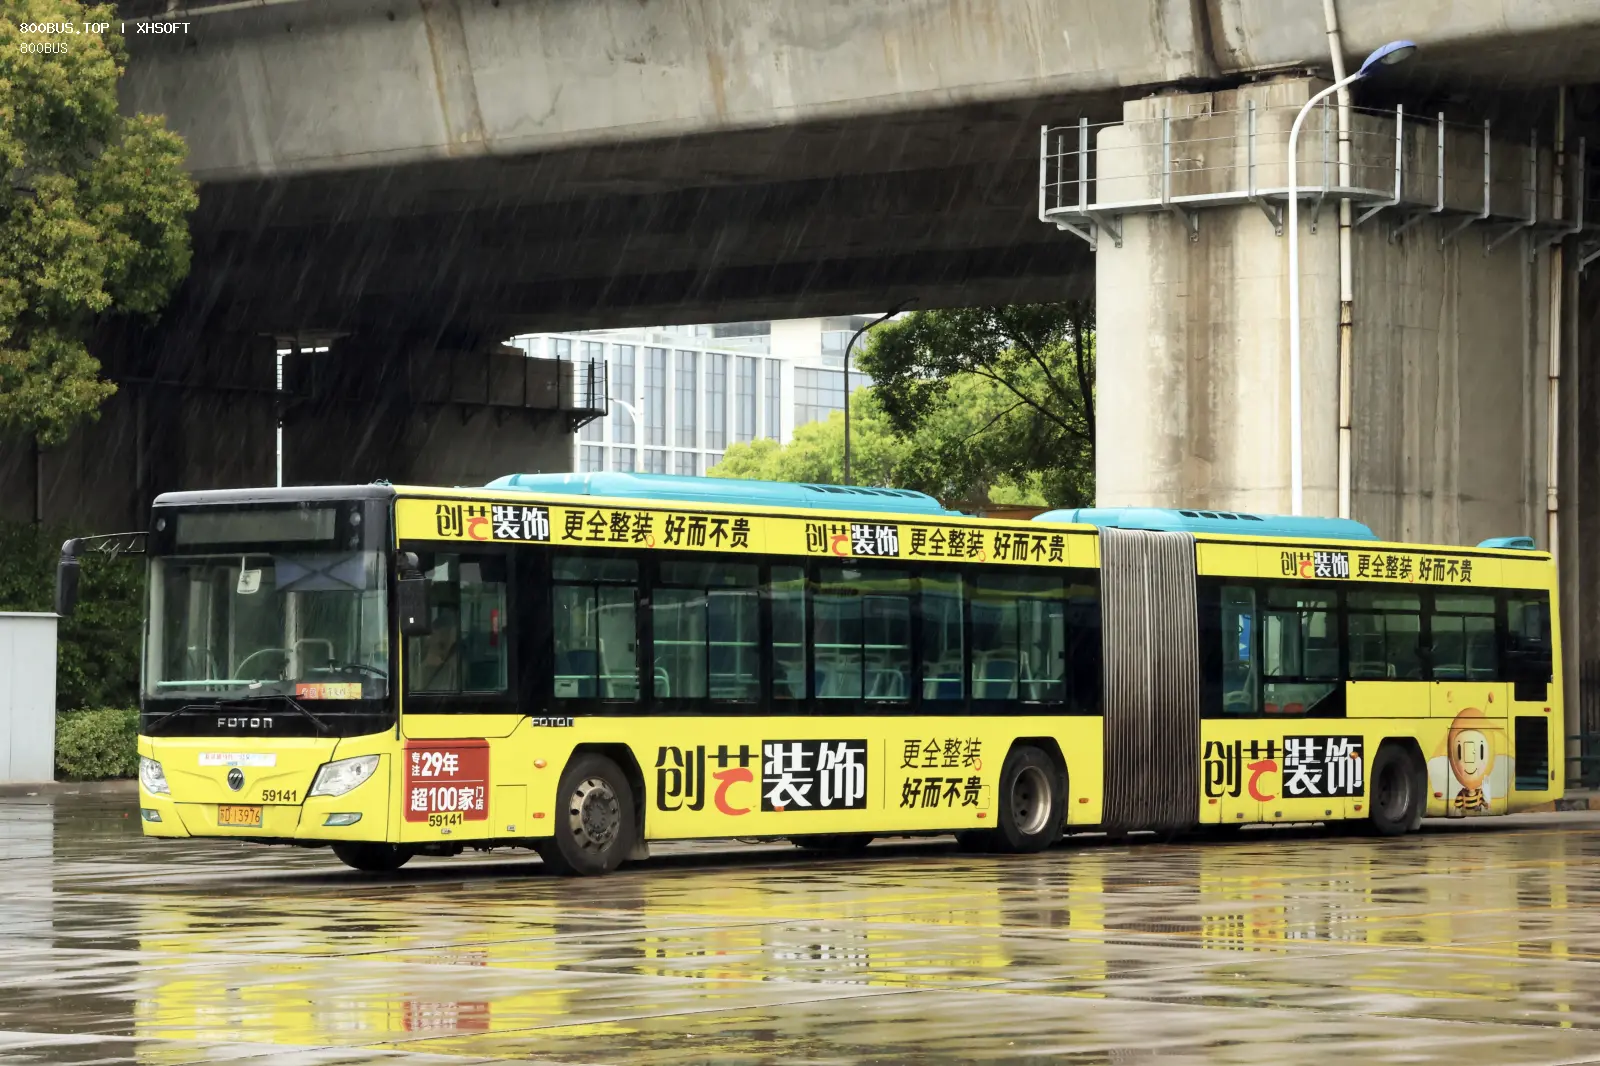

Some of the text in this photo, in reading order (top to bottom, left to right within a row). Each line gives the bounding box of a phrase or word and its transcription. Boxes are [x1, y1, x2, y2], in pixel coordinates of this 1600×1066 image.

[561, 509, 655, 548] 更全整装
[664, 514, 751, 549] 好而不贵
[909, 528, 986, 562] 更全整装
[993, 532, 1065, 563] 好而不贵
[1356, 554, 1414, 582] 更全整装
[1418, 557, 1473, 583] 好而不贵
[900, 737, 982, 771] 更全整装
[262, 789, 296, 801] 59141
[899, 775, 982, 809] 好而不贵
[429, 814, 462, 827] 59141
